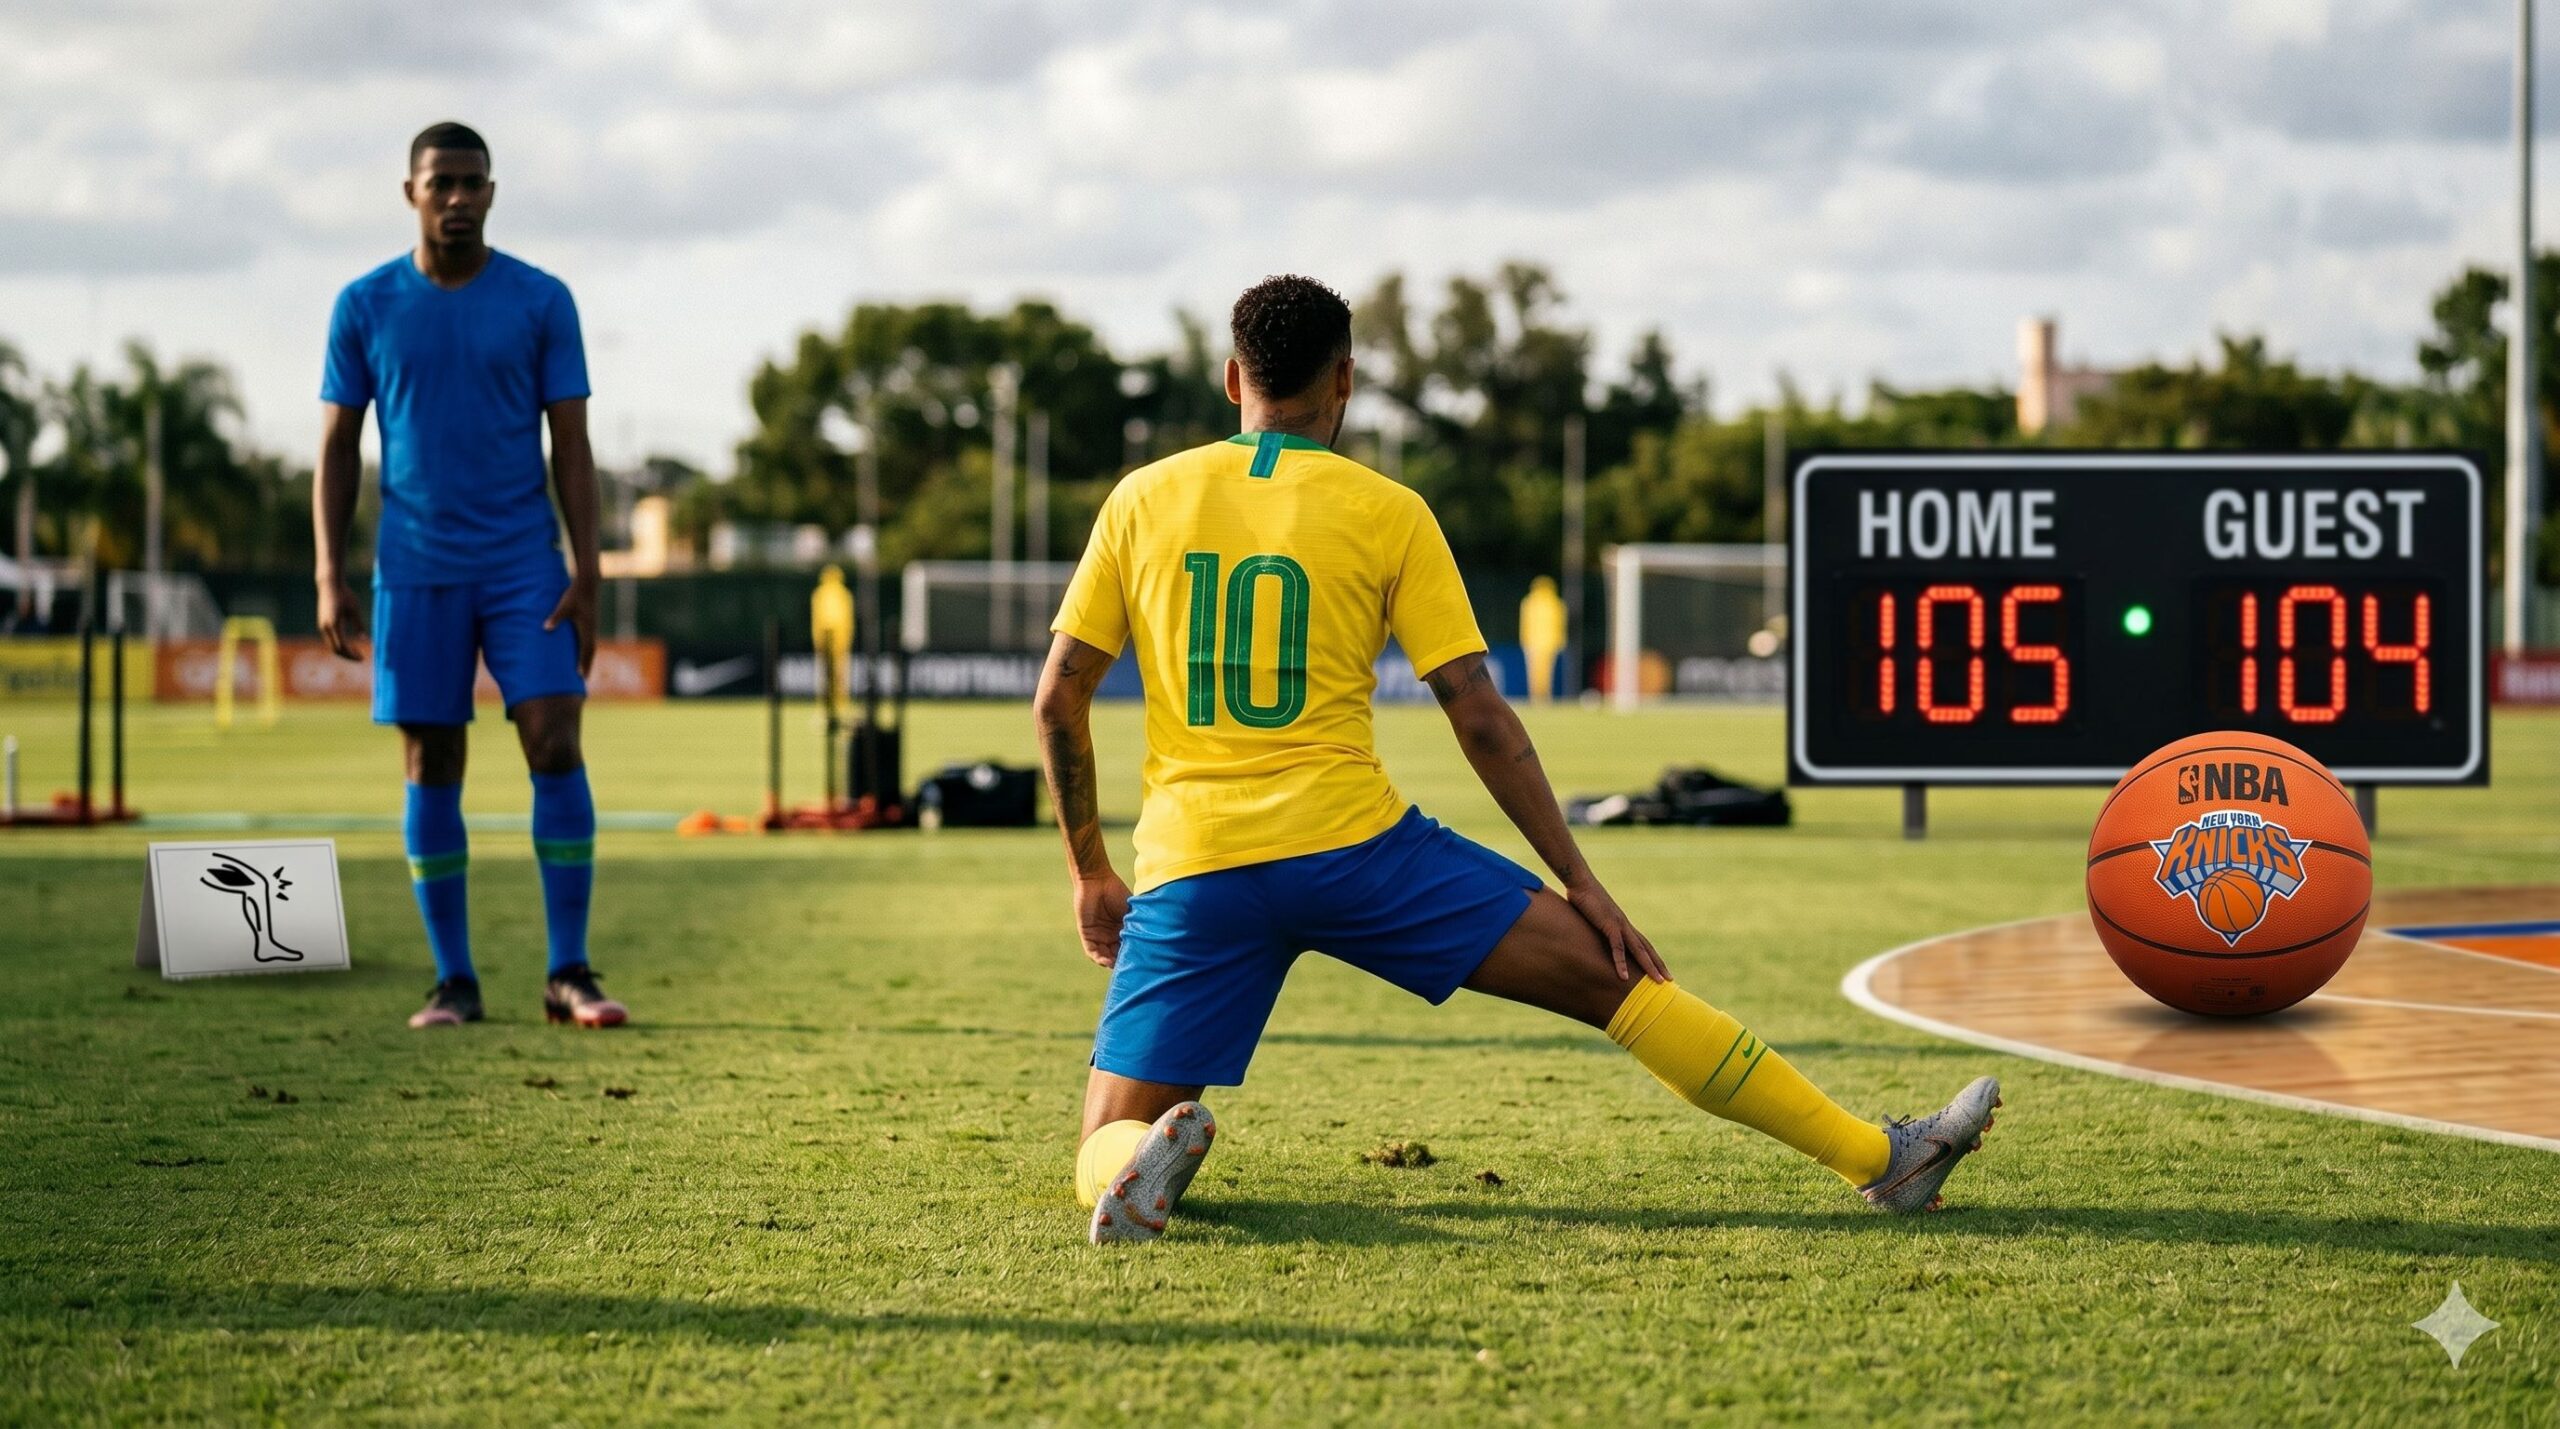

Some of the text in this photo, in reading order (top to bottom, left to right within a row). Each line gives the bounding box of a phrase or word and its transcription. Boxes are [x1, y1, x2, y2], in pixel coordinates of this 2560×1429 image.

[1858, 489, 2425, 560] HOME GUEST
[1184, 552, 1311, 728] 10
[1877, 584, 2432, 724] 105 104
[2204, 763, 2289, 806] NBA
[2202, 813, 2228, 828] NEW
[2158, 826, 2302, 882] KNICKS
